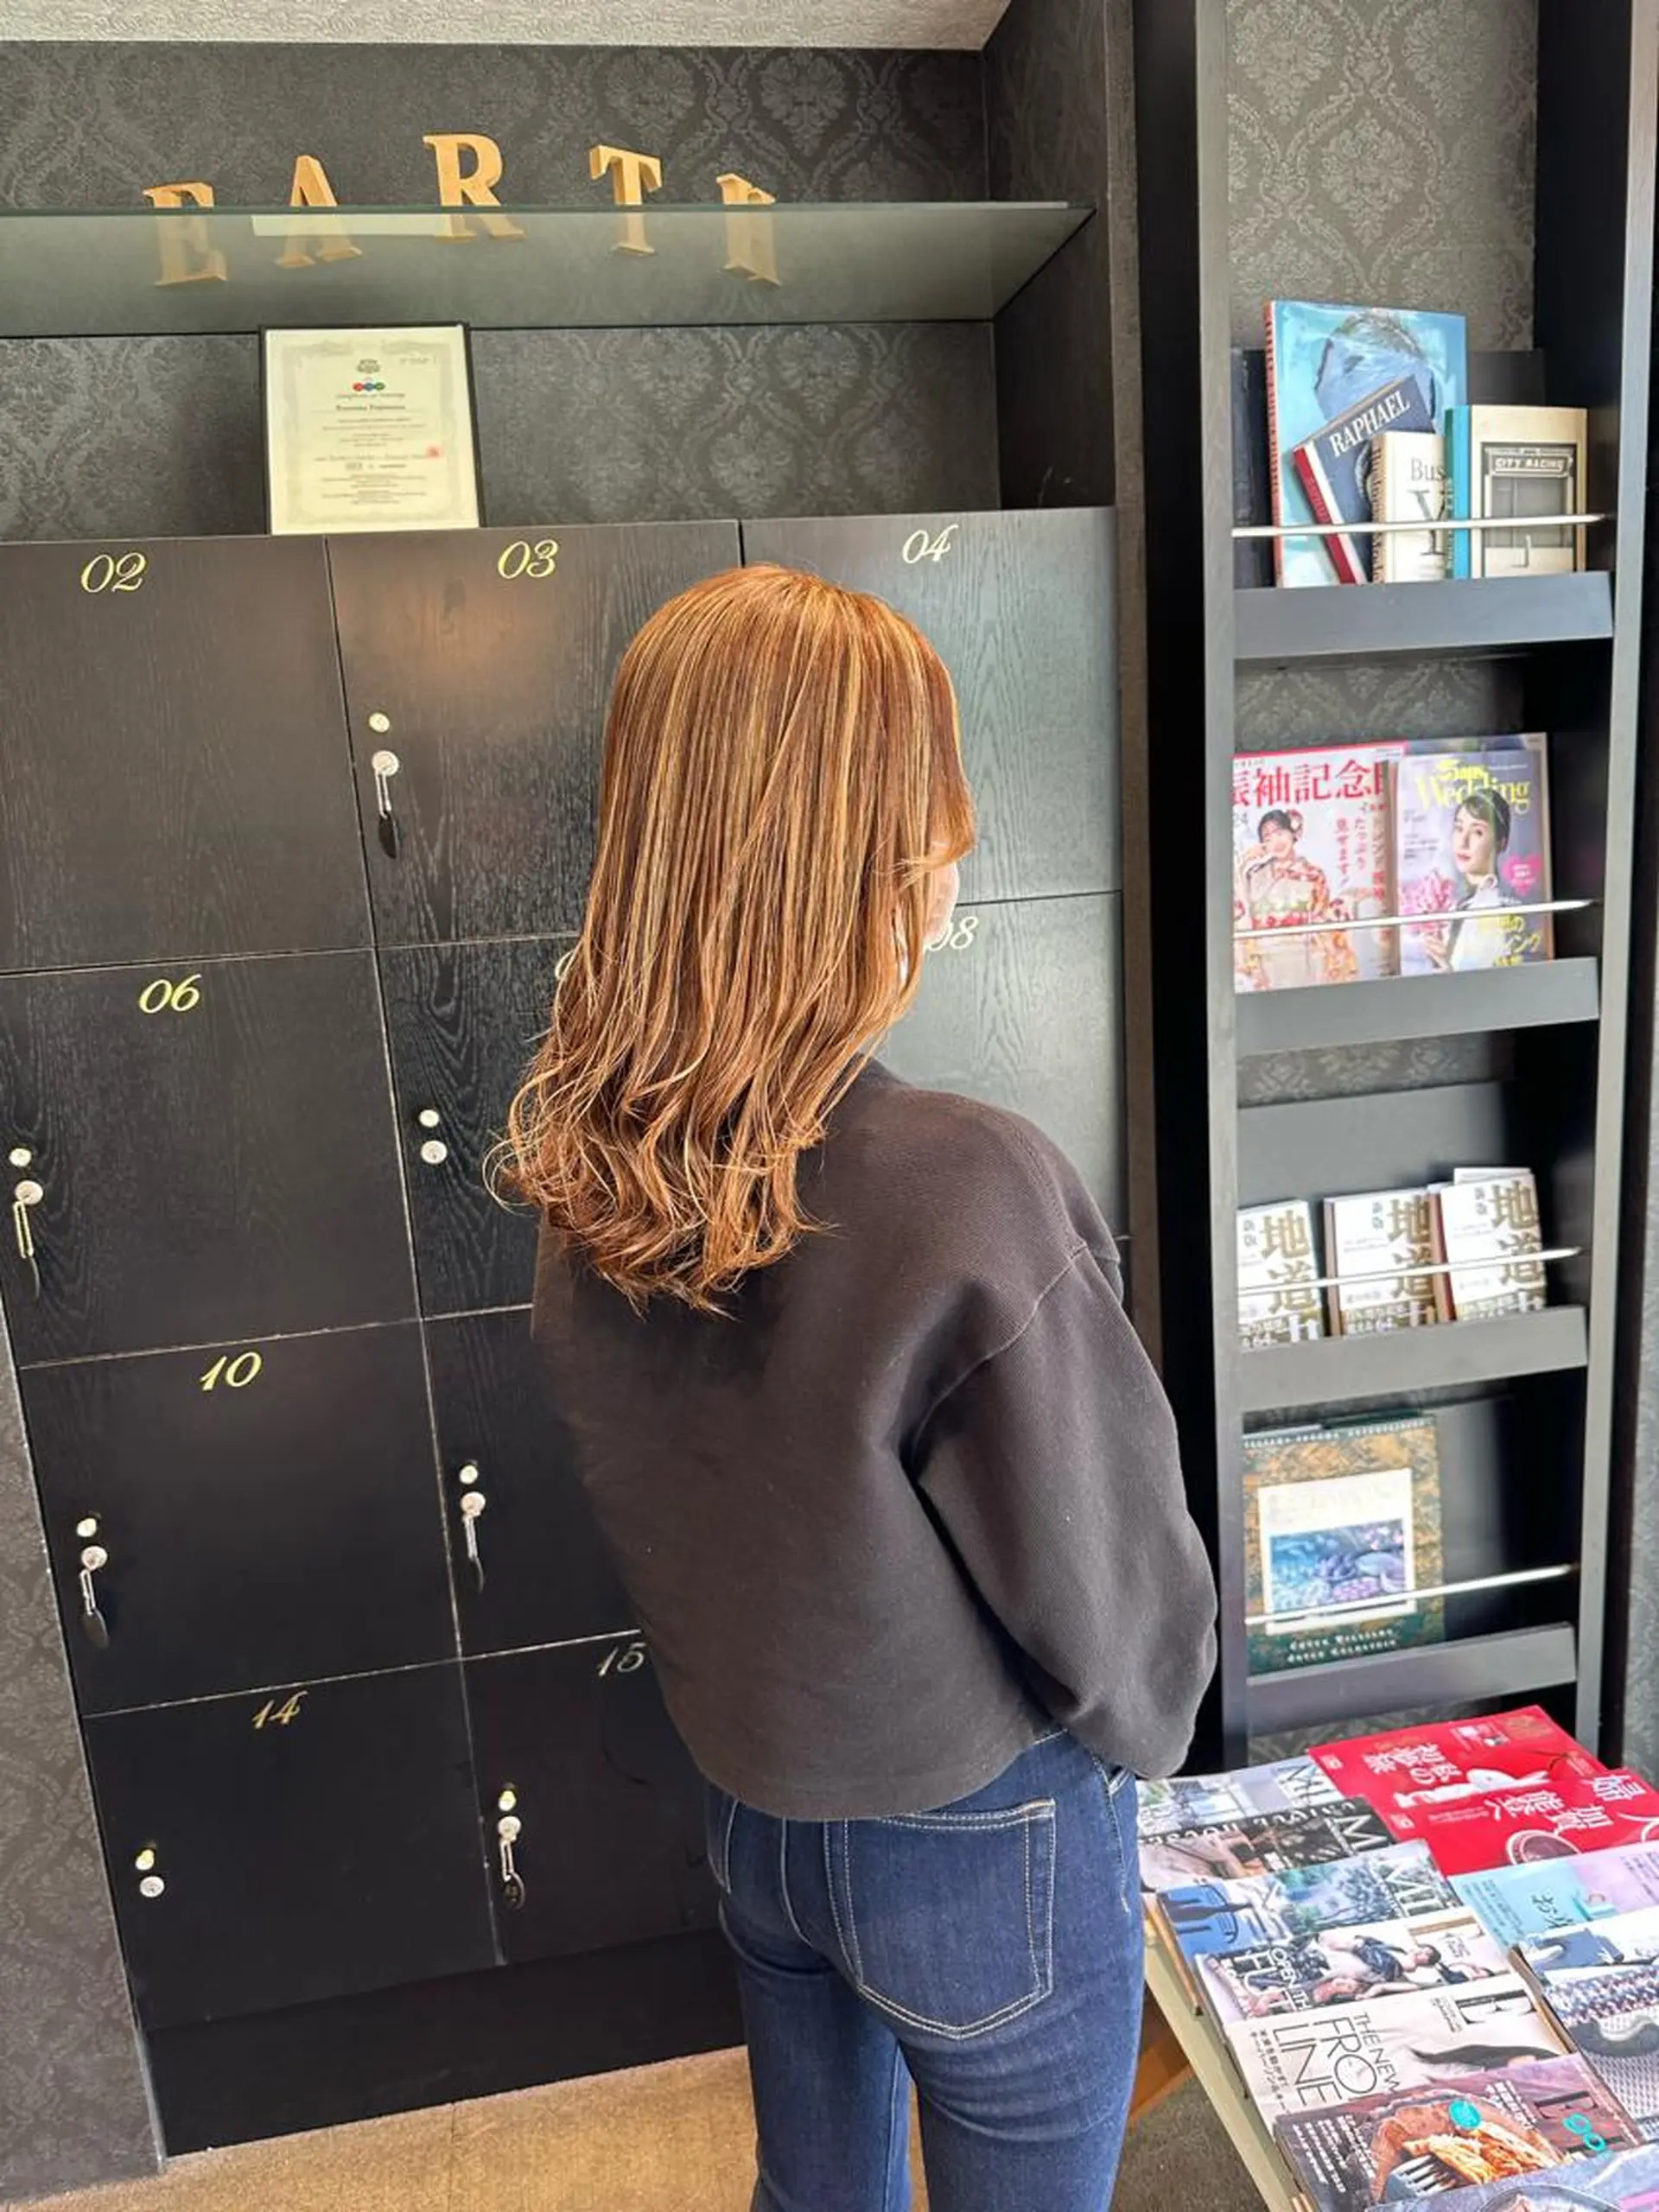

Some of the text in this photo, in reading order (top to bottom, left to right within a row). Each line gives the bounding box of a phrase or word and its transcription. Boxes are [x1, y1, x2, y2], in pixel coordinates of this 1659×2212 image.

[1329, 391, 1411, 457] RAPHAEL
[1495, 458, 1524, 471] CITY
[498, 539, 558, 580] 03
[902, 524, 959, 564] 04
[81, 552, 146, 593] 02
[138, 974, 202, 1014] 06
[200, 1351, 262, 1391] 10
[596, 1643, 646, 1677] 15
[251, 1690, 308, 1729] 14
[1354, 2012, 1381, 2047] THE
[1273, 2023, 1343, 2107] LINE
